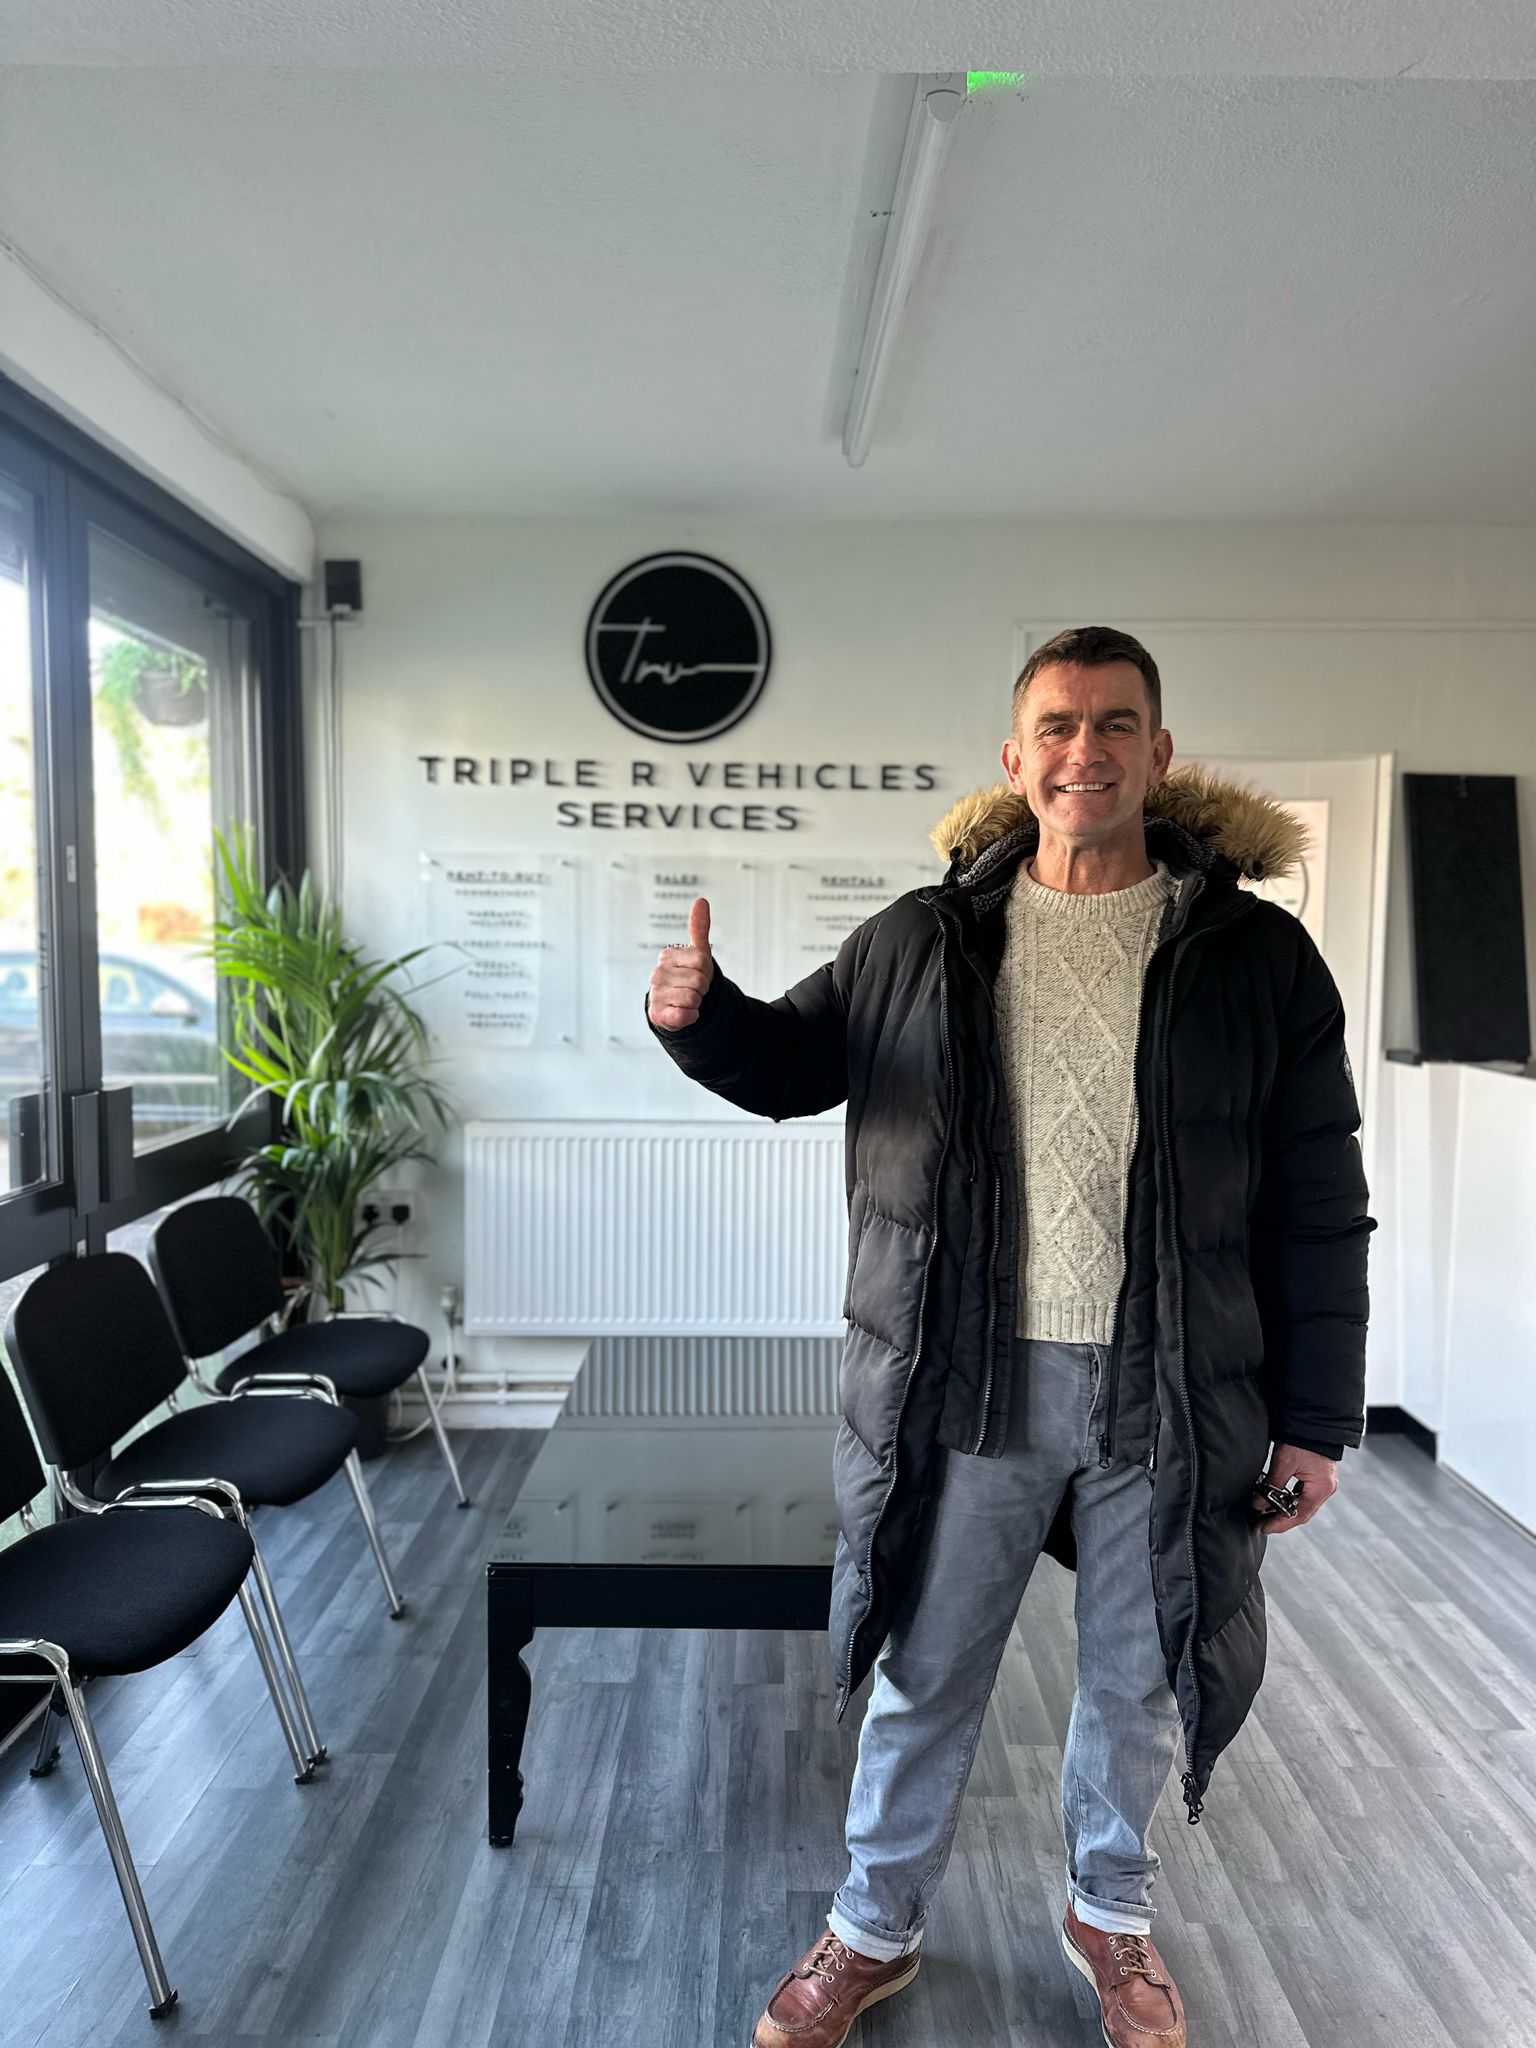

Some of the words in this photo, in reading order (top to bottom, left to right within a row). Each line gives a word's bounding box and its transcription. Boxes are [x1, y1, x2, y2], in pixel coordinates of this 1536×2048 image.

[418, 756, 598, 789] TRIPLE
[632, 761, 655, 788] R
[687, 762, 936, 791] VEHICLES
[556, 801, 799, 832] SERVICES
